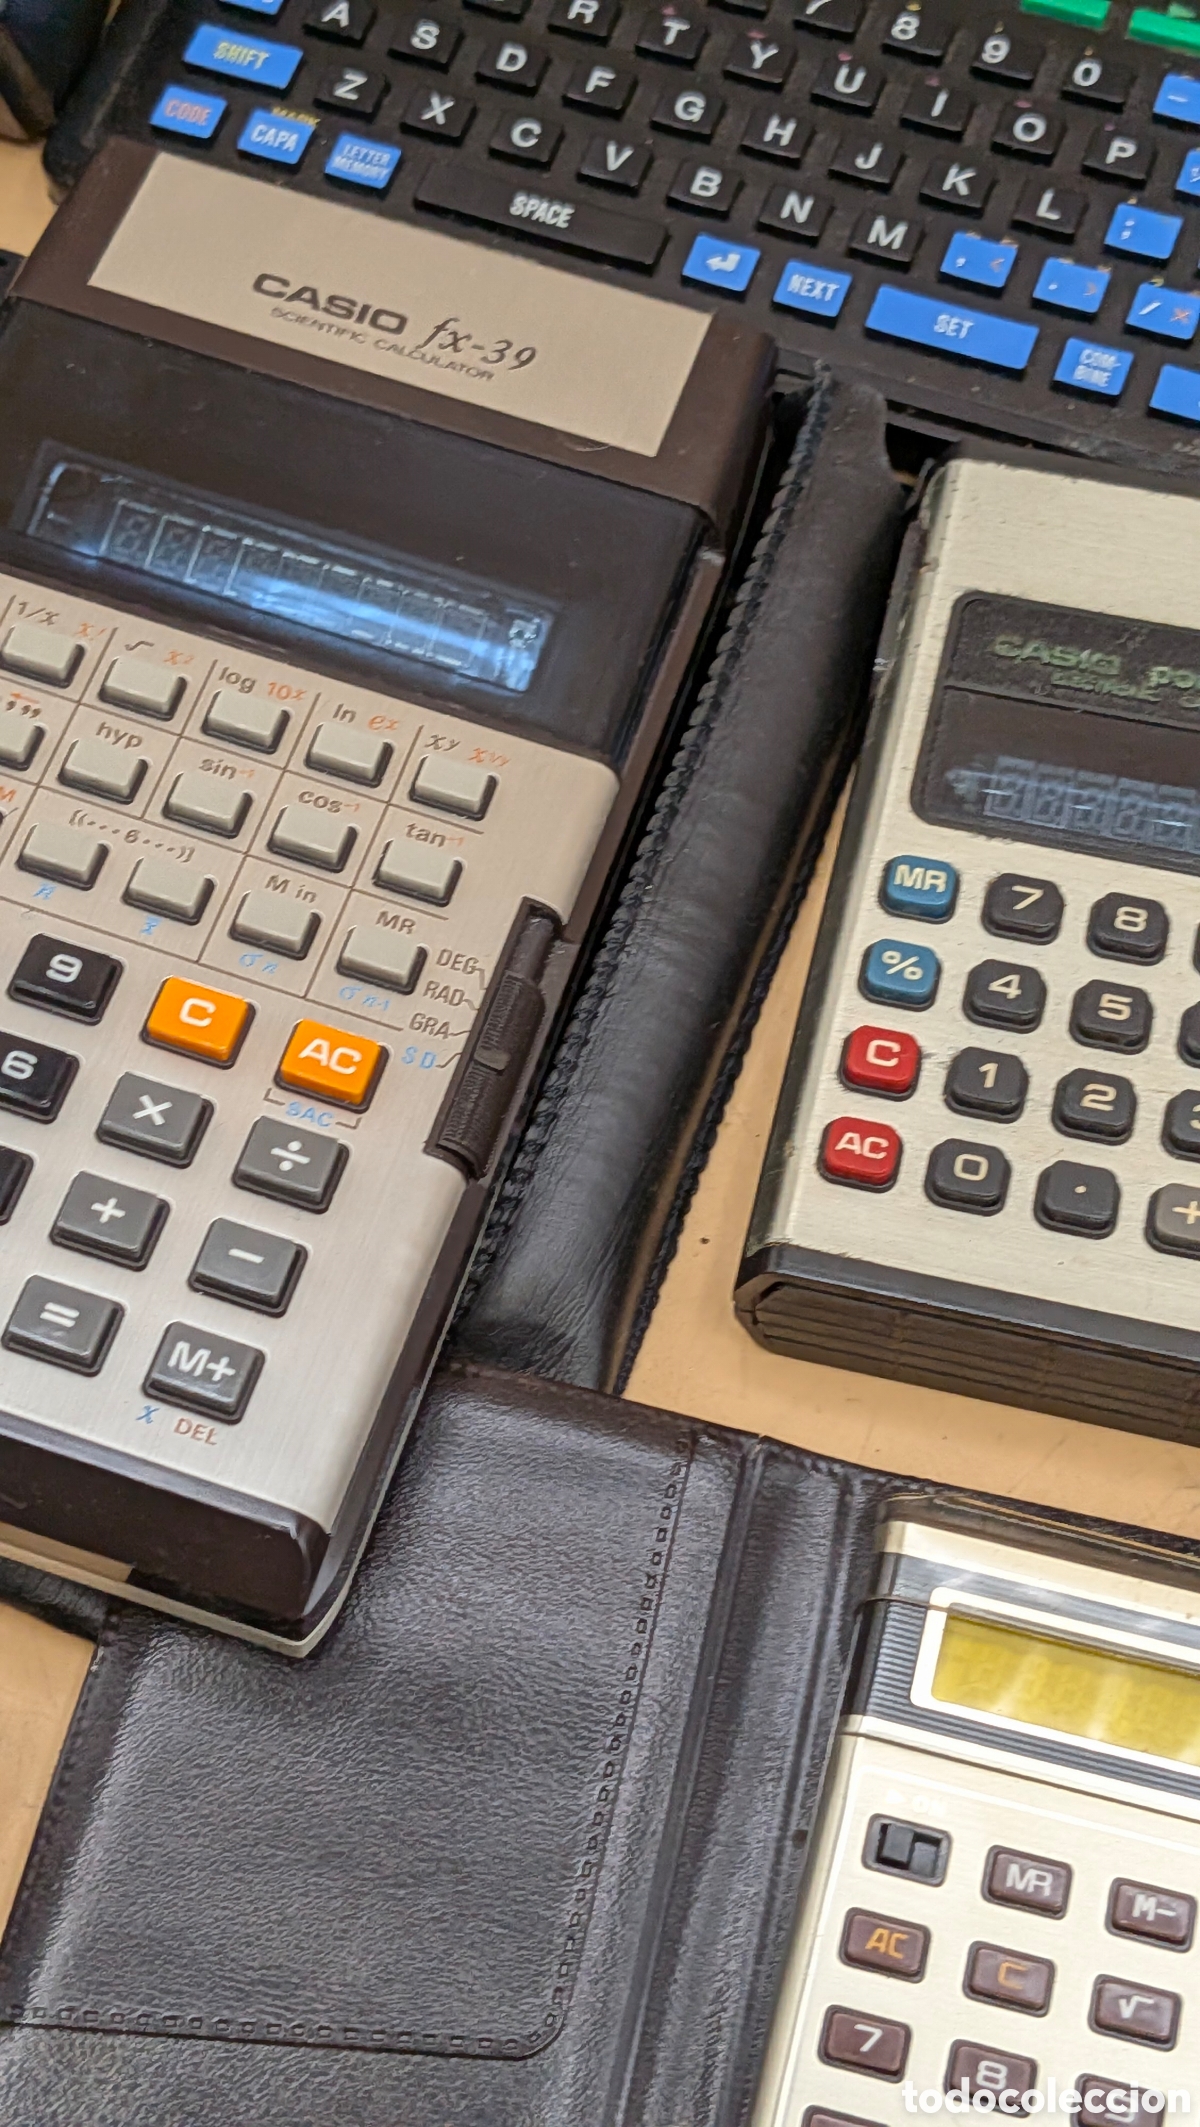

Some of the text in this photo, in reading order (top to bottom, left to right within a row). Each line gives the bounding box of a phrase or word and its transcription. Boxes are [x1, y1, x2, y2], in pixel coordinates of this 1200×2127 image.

[321, 1, 350, 28] A
[567, 0, 599, 24] R
[891, 12, 920, 41] 8
[410, 20, 440, 50] S
[663, 17, 690, 46] T
[213, 39, 271, 70] SHIFT
[496, 43, 527, 72] D
[750, 40, 779, 70] Y
[982, 33, 1011, 64] 9
[334, 69, 368, 100] Z
[585, 66, 616, 93] F
[834, 63, 867, 94] U
[164, 98, 212, 127] CODE
[420, 91, 455, 125] X
[674, 91, 706, 122] G
[931, 88, 949, 117] I
[251, 124, 298, 152] CAPA
[511, 118, 542, 148] C
[763, 113, 797, 147] H
[343, 143, 391, 166] LETTER
[607, 140, 634, 171] V
[855, 142, 883, 170] J
[1106, 136, 1137, 164] P
[690, 166, 722, 197] B
[942, 163, 977, 196] K
[510, 189, 575, 228] SPACE
[780, 191, 814, 223] N
[1036, 187, 1061, 220] L
[867, 215, 908, 250] M
[787, 273, 840, 302] NEXT
[252, 272, 538, 372] CASIO fx-39
[933, 313, 974, 339] SET
[270, 305, 496, 383] SCIENTIFIC CALCULATOR
[218, 666, 257, 695] log
[95, 721, 144, 750] hyp
[265, 874, 317, 904] M in
[894, 864, 947, 894] MR
[1011, 884, 1044, 911] 7
[375, 911, 416, 935] MR
[1113, 906, 1147, 934] 8
[46, 953, 84, 983] 9
[436, 948, 479, 976] DEG
[882, 949, 924, 981] %
[422, 980, 466, 1007] RAD
[988, 974, 1022, 1000] 4
[179, 997, 217, 1028] C
[1098, 993, 1133, 1021] 5
[409, 1012, 450, 1040] GRA
[1, 1050, 38, 1080] 6
[298, 1038, 362, 1075] AC
[866, 1039, 901, 1068] C
[978, 1062, 1000, 1089] 1
[1080, 1083, 1118, 1112] 2
[285, 1101, 336, 1128] SAC
[835, 1132, 890, 1160] AC
[167, 1340, 236, 1382] M+
[174, 1417, 218, 1446] DEL
[1006, 1863, 1053, 1897] MR
[865, 1927, 908, 1959] AC
[997, 1960, 1028, 1991] C
[853, 2024, 883, 2052] 7
[976, 2060, 1008, 2091] 8
